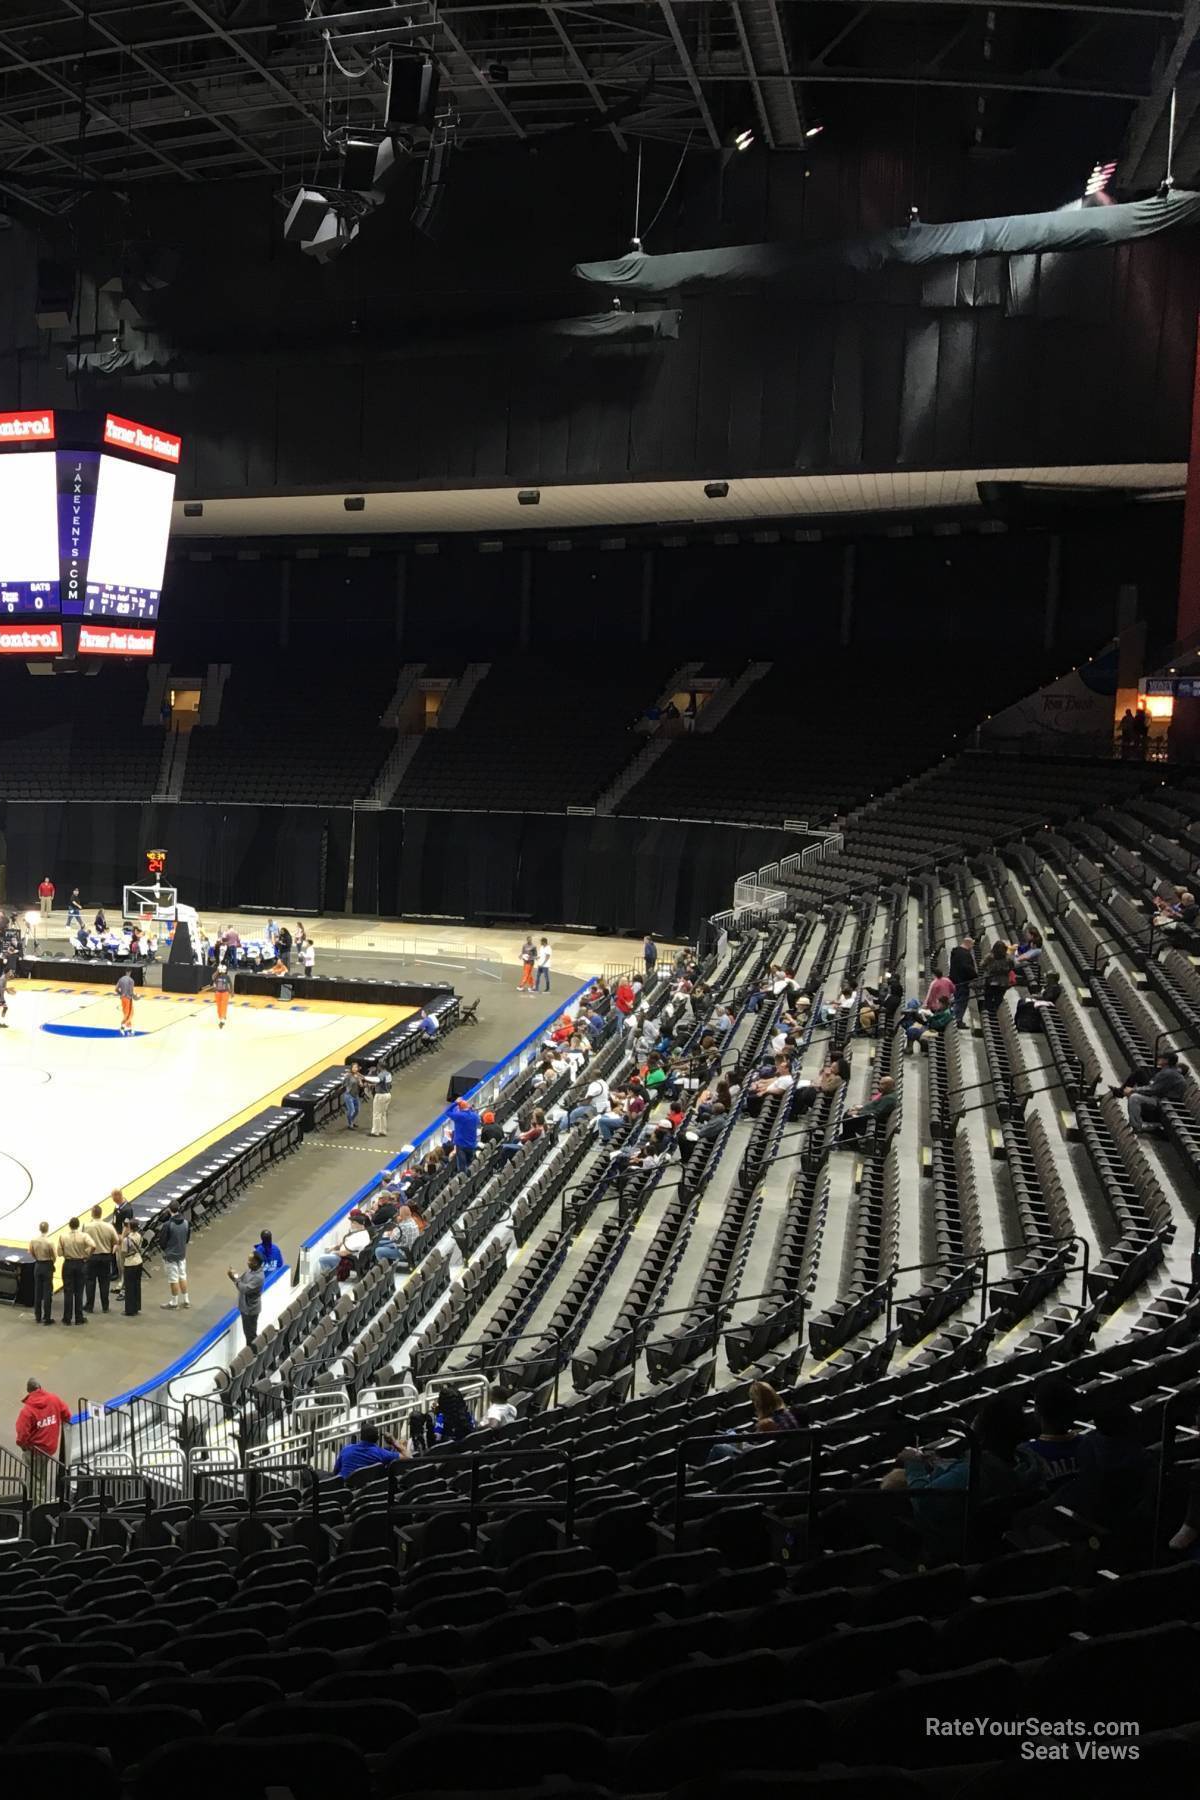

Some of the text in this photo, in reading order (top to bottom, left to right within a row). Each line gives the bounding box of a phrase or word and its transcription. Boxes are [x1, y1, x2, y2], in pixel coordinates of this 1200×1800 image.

[106, 419, 179, 457] Turner Pest Control
[7, 603, 14, 613] 0
[34, 596, 44, 609] 0
[149, 860, 163, 871] 24
